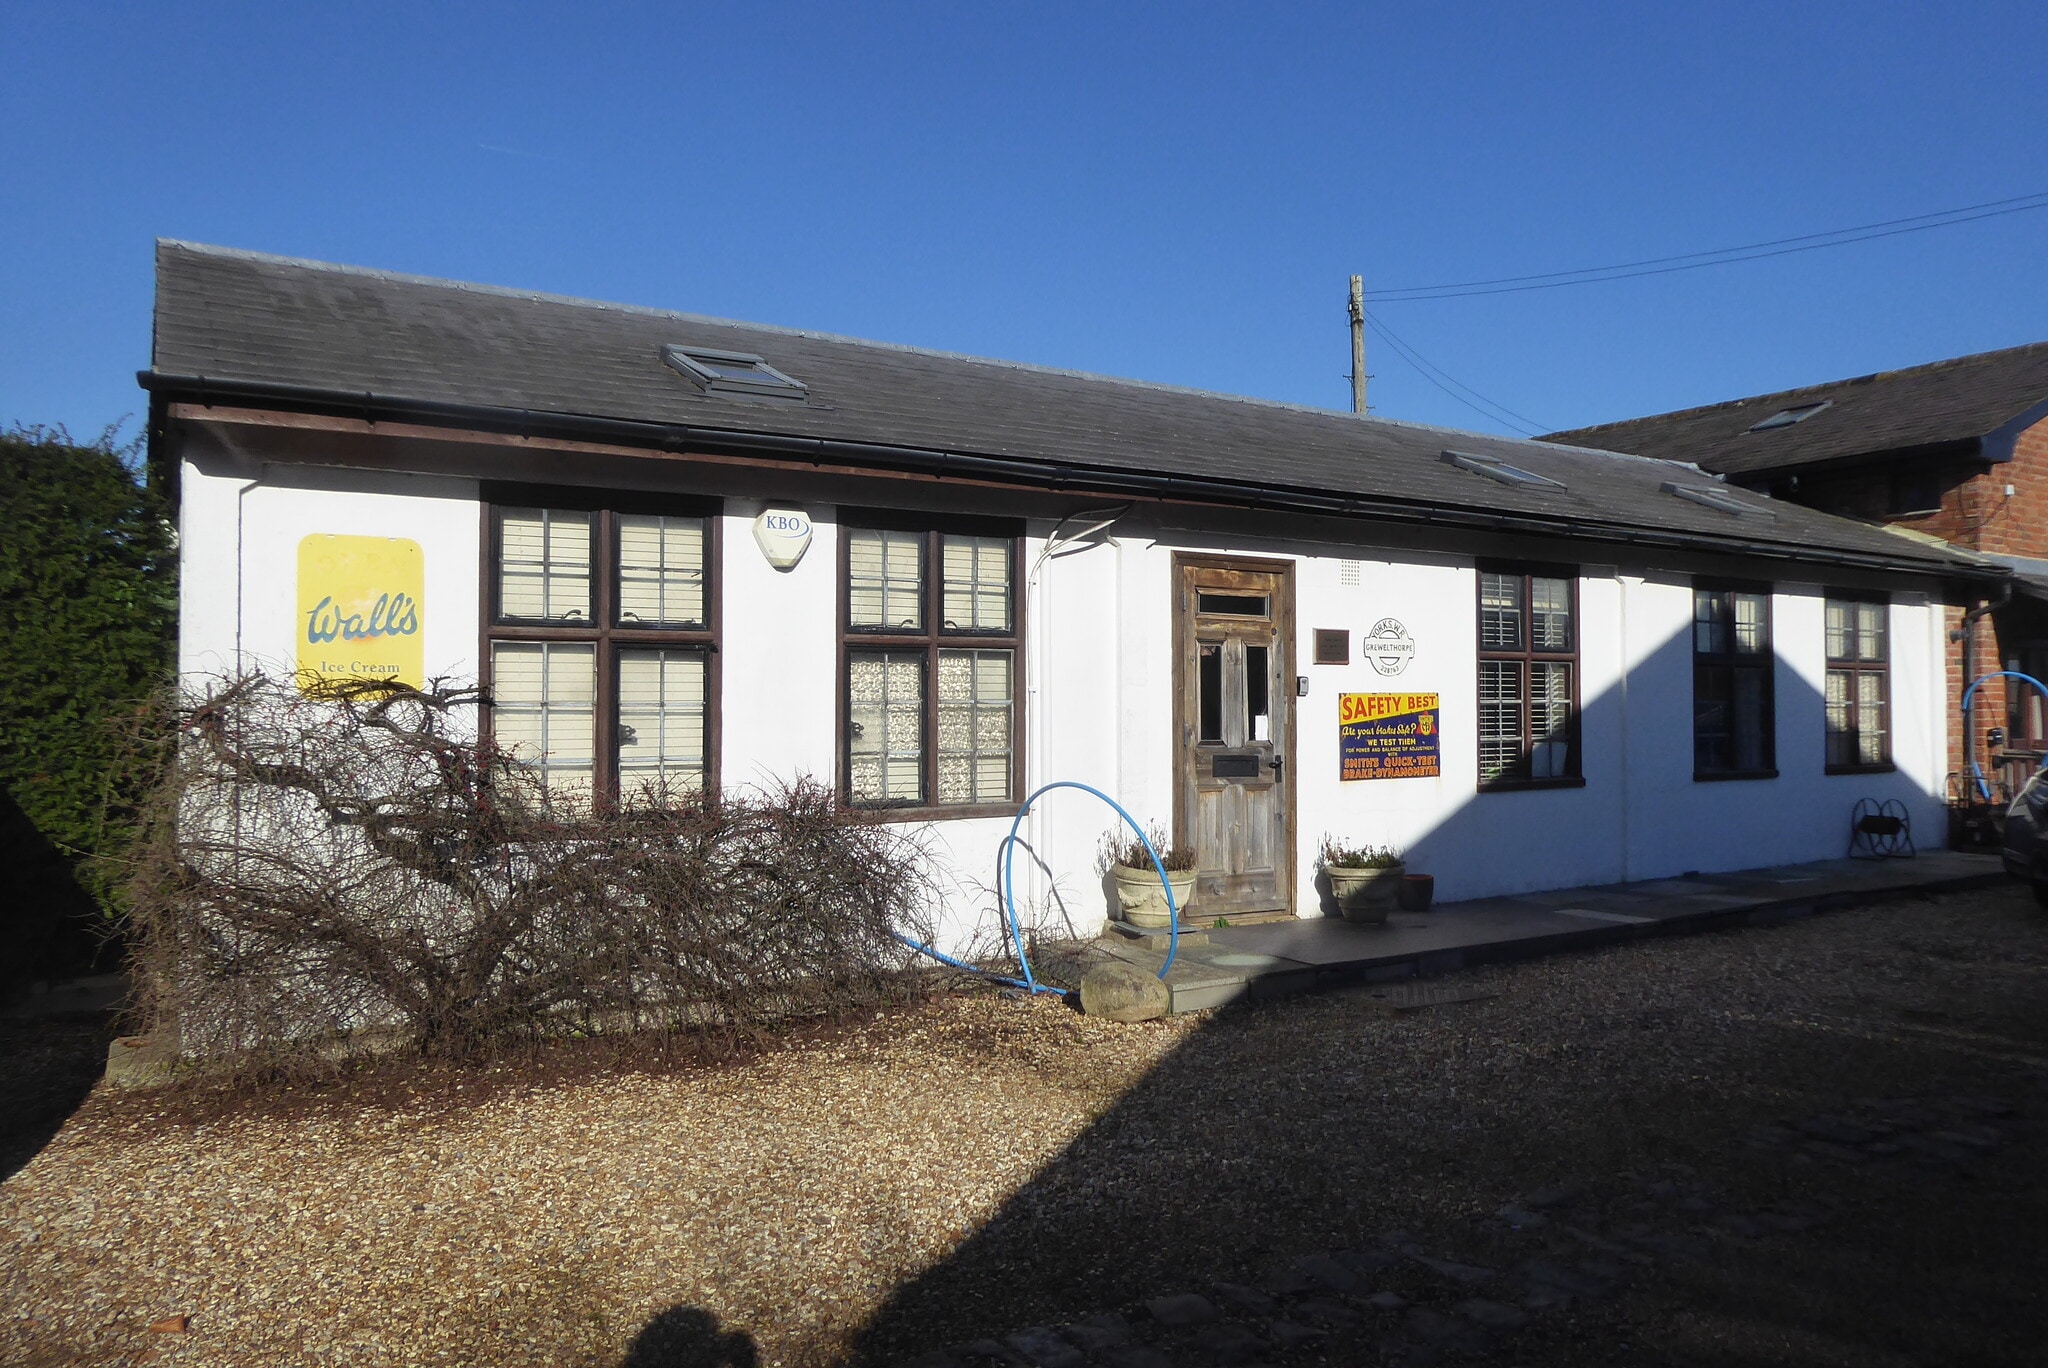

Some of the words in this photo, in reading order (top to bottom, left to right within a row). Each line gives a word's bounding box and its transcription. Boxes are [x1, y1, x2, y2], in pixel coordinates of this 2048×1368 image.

[766, 515, 800, 530] KBO
[306, 592, 418, 644] Wall's
[1365, 643, 1413, 652] GREWELTHORPE
[321, 661, 345, 673] Ice
[350, 661, 400, 673] Cream
[1342, 696, 1402, 721] SAFETY
[1407, 696, 1436, 710] BEST
[1357, 727, 1374, 740] your
